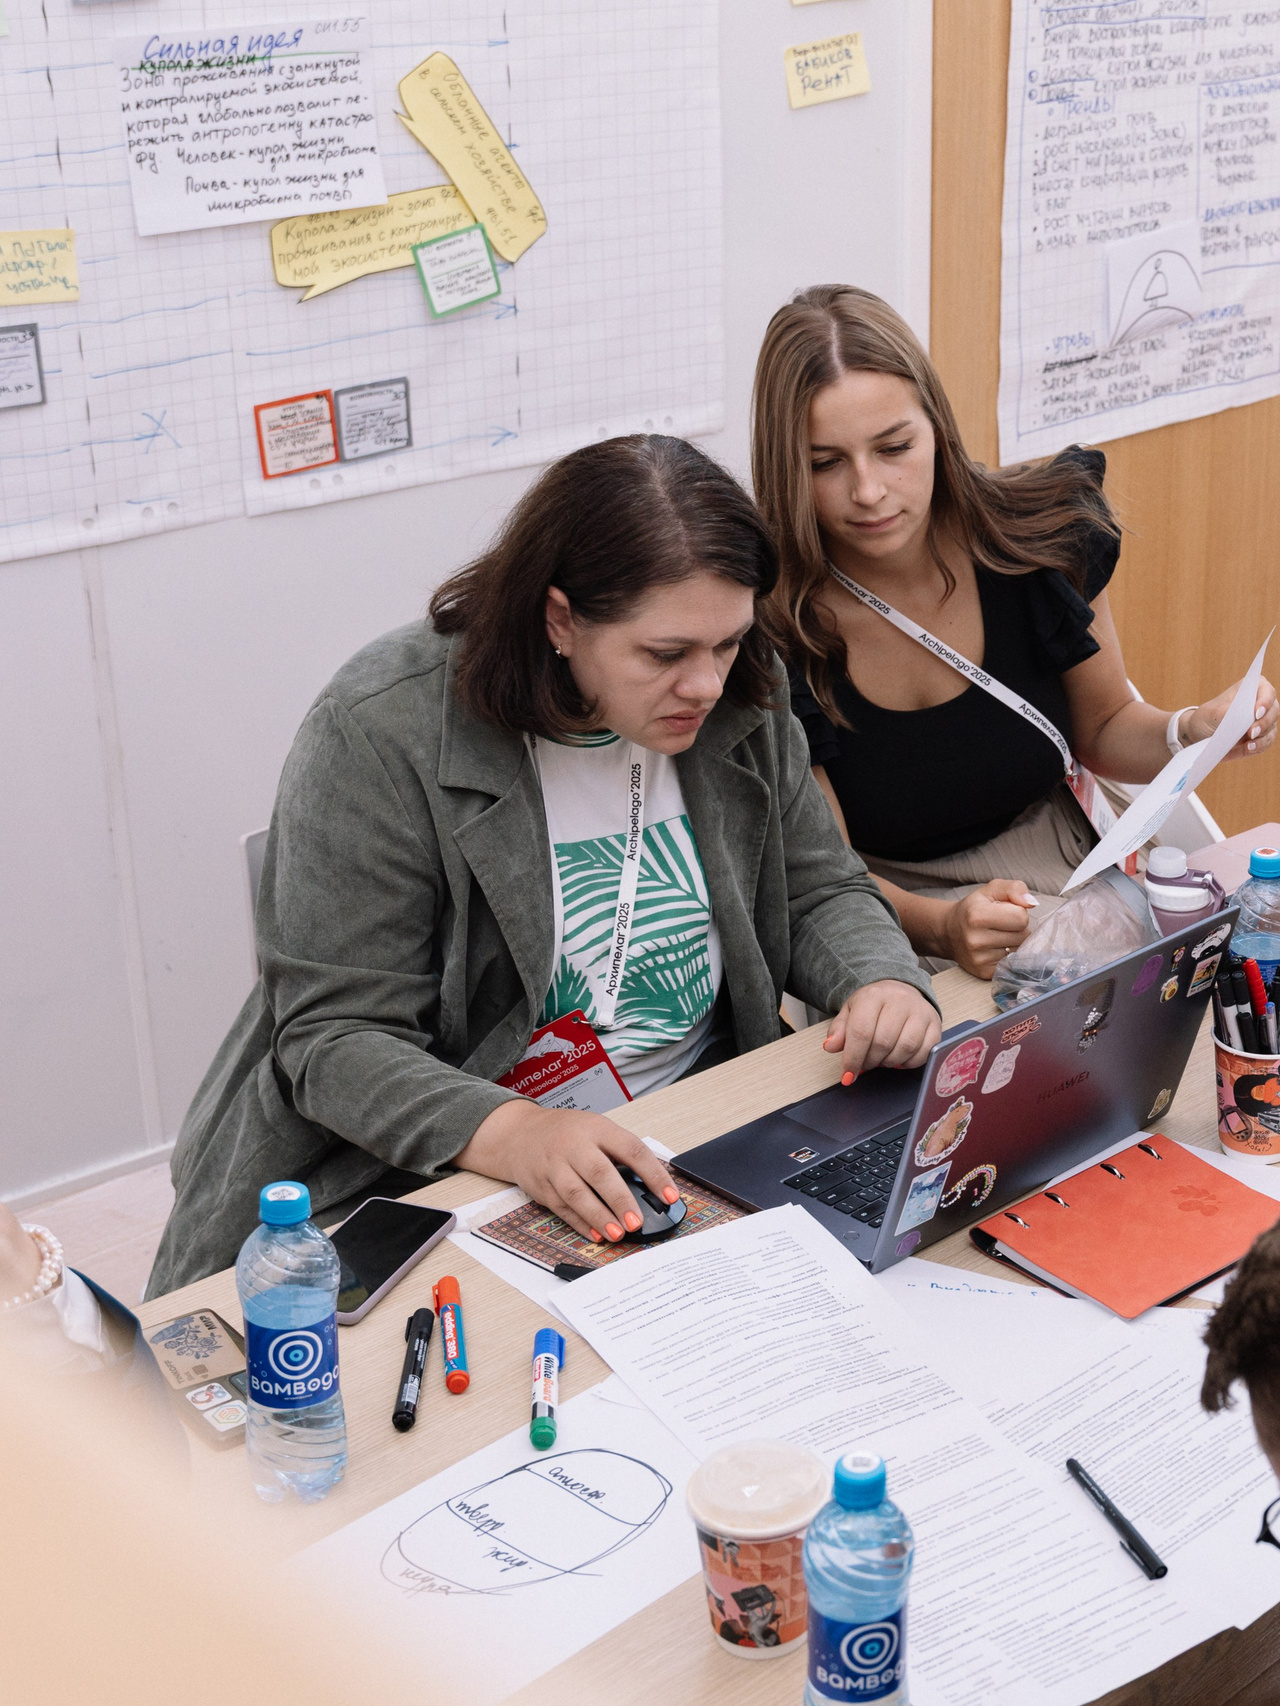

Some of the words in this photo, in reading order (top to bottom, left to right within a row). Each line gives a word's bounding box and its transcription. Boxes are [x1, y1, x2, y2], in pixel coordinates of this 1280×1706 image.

[143, 34, 239, 60] Сильная
[247, 28, 304, 73] идея
[509, 1039, 597, 1093] хипелаг'2025
[524, 1064, 580, 1097] rchipelago'2025
[552, 1096, 575, 1109] ТАЛИЯ
[1036, 1070, 1090, 1104] HUAWEI
[444, 1311, 455, 1340] edding
[447, 1339, 458, 1359] 380
[164, 1360, 185, 1384] TINKOFF
